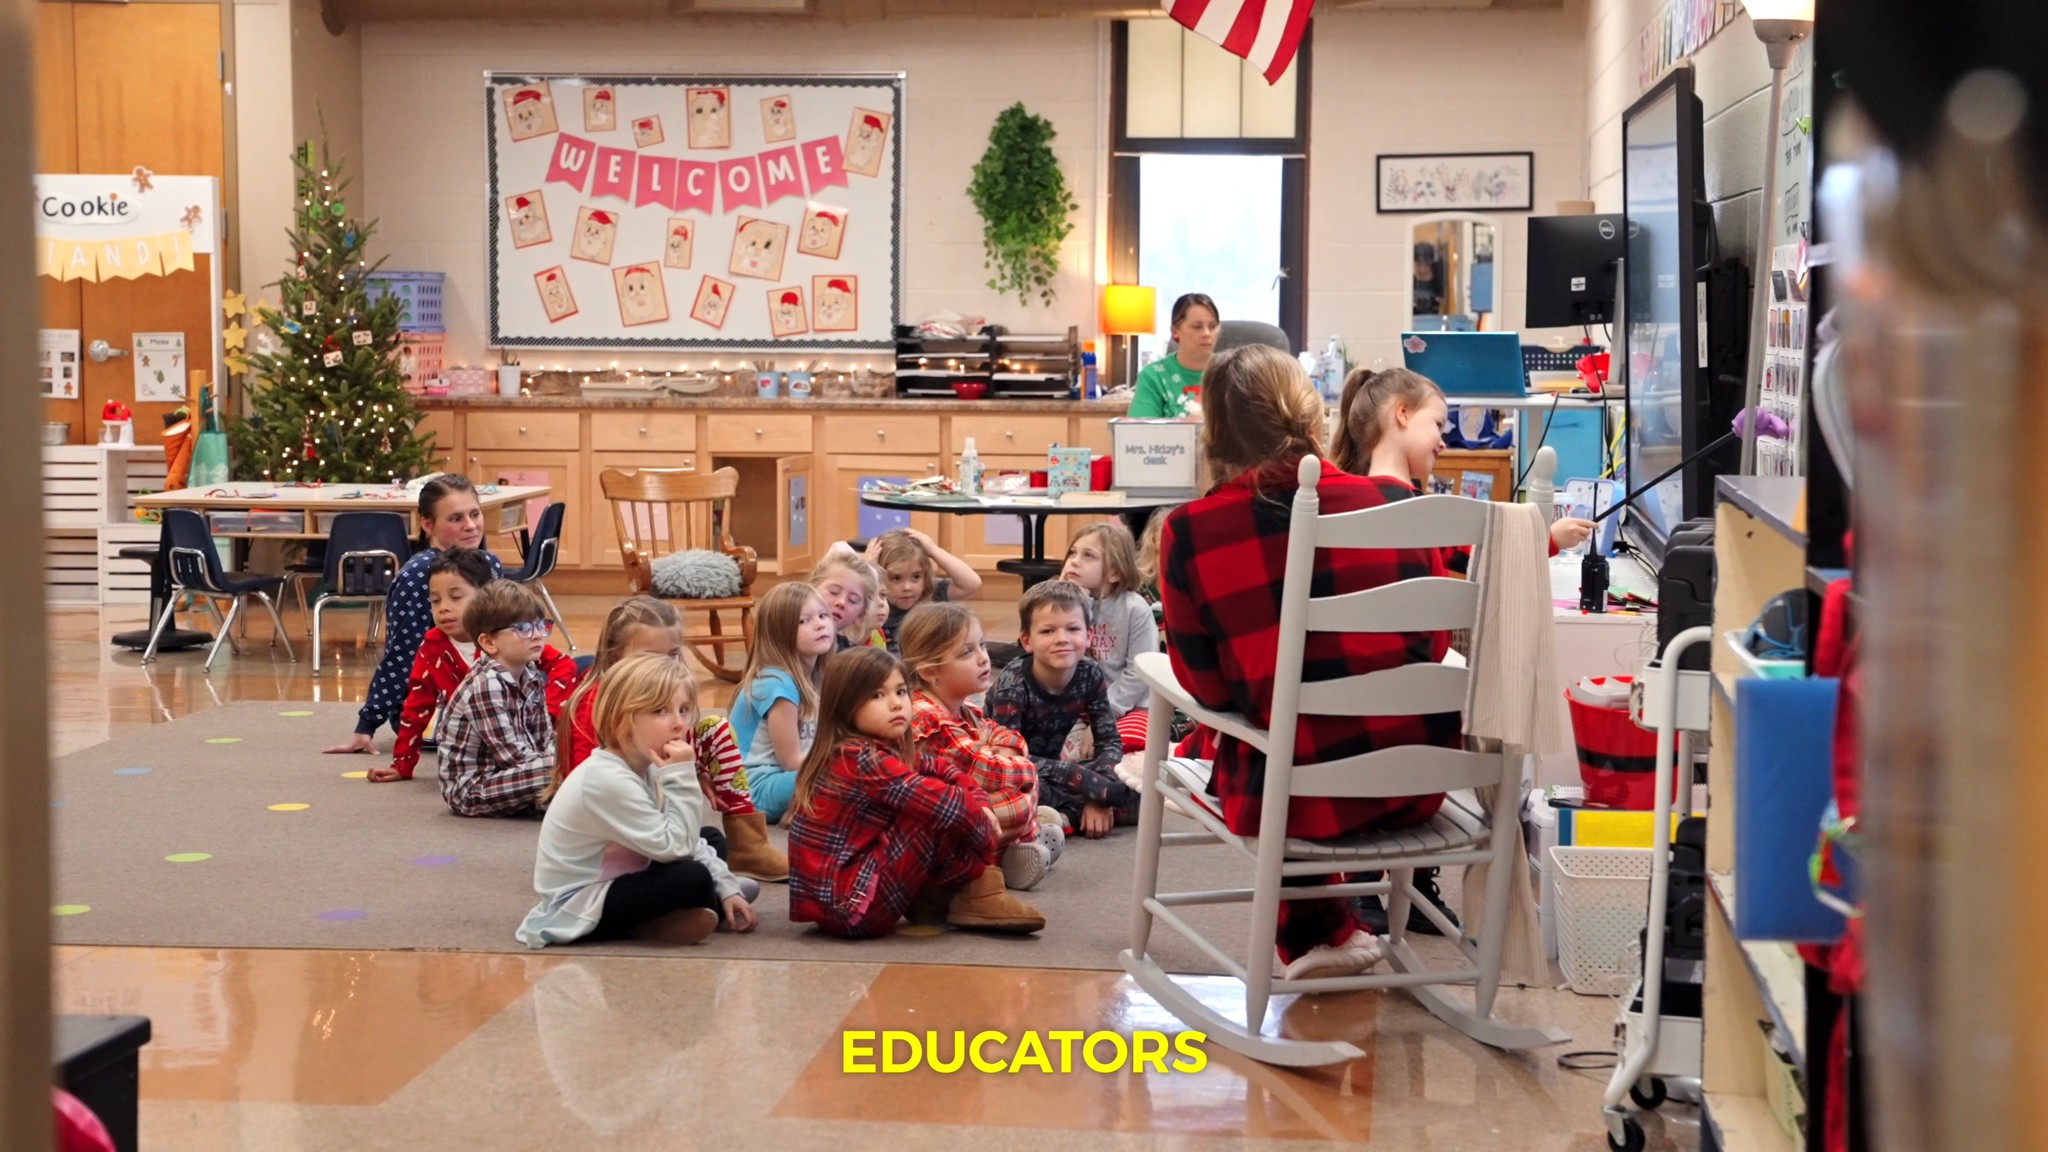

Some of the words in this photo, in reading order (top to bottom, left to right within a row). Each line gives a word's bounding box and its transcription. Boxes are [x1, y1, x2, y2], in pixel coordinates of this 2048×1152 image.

[559, 142, 832, 196] WELCOME
[42, 193, 129, 218] Cookie
[47, 235, 181, 266] TAND!
[1125, 445, 1146, 454] Mrs.
[1143, 456, 1167, 465] desk
[1090, 636, 1117, 648] DAY
